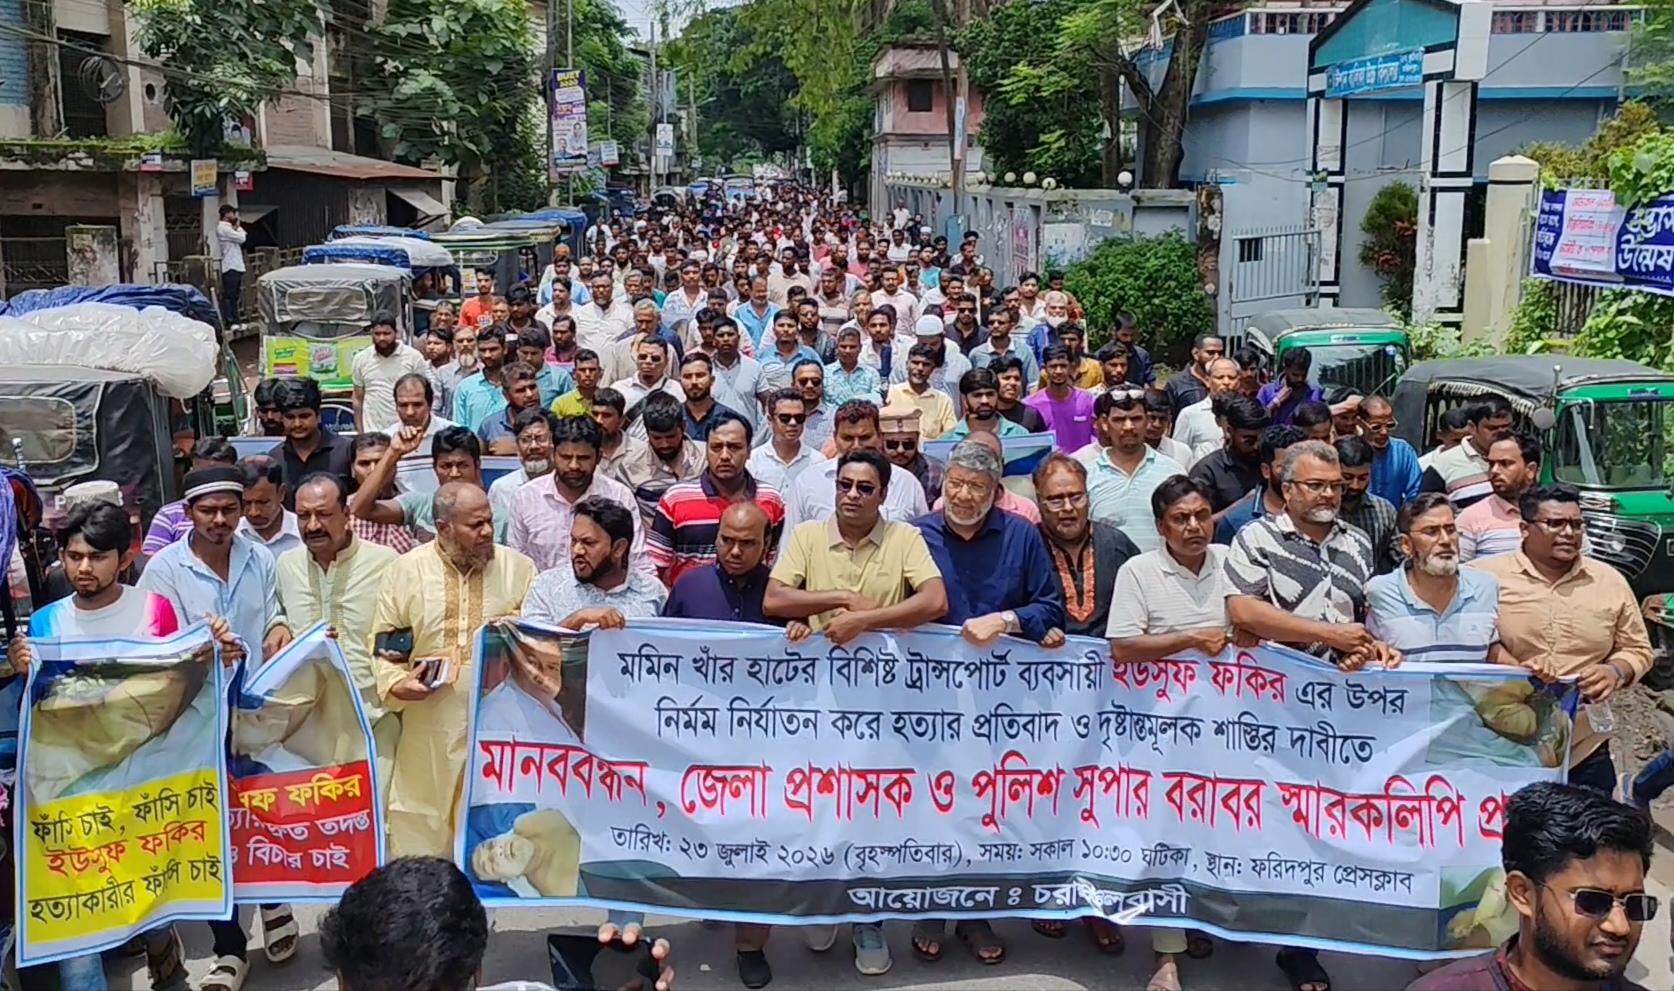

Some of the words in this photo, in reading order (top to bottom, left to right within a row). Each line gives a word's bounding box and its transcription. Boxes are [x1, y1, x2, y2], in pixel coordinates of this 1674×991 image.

[617, 643, 683, 685] মমিন
[692, 646, 739, 685] খাঁর
[745, 648, 820, 687] হাটের
[826, 645, 899, 688] বিশিষ্ট
[905, 647, 1012, 693] ট্রান্সপোর্ট
[1017, 650, 1105, 691] ব্যবসায়ী
[1208, 651, 1288, 703] ফকির
[1296, 681, 1336, 711] এর
[1345, 679, 1409, 715] উপর
[654, 695, 720, 738] নির্মম
[727, 696, 821, 740] নির্যাতন
[828, 710, 883, 741] করে
[890, 709, 965, 742] হত্যার
[972, 702, 1063, 745] প্রতিবাদ
[1071, 714, 1091, 739] ও
[1097, 700, 1205, 755] দৃষ্টান্তমূলক
[1212, 711, 1279, 753] শাস্তির
[1286, 721, 1377, 764] দাবীতে
[132, 788, 181, 822] ফাঁসি
[186, 778, 219, 812] চাই
[284, 772, 362, 807] ফকির
[681, 760, 773, 819] জেলা
[784, 761, 917, 822] প্রশাসক
[927, 770, 955, 814] ও
[972, 750, 1066, 833] পুলিশ
[1073, 762, 1153, 829] সুপার
[1161, 771, 1267, 831] বরাবর
[1273, 775, 1466, 848] স্মারকলিপি
[136, 821, 207, 855] ফকির
[314, 809, 370, 835] তদন্ত
[246, 835, 303, 870] বিচার
[308, 842, 351, 870] চাই
[679, 837, 708, 860] ২৩
[716, 837, 771, 868] জুলাই
[778, 844, 835, 868] ২০২৬
[1029, 838, 1076, 861] সকাল
[1082, 839, 1131, 863] ১০:৩০
[1250, 851, 1327, 887] ফরিদপুর
[1334, 863, 1414, 894] প্রেসক্লাব
[28, 876, 135, 923] হত্যাকারীর
[188, 852, 222, 883] চাই
[847, 886, 1000, 909] আয়োজনে
